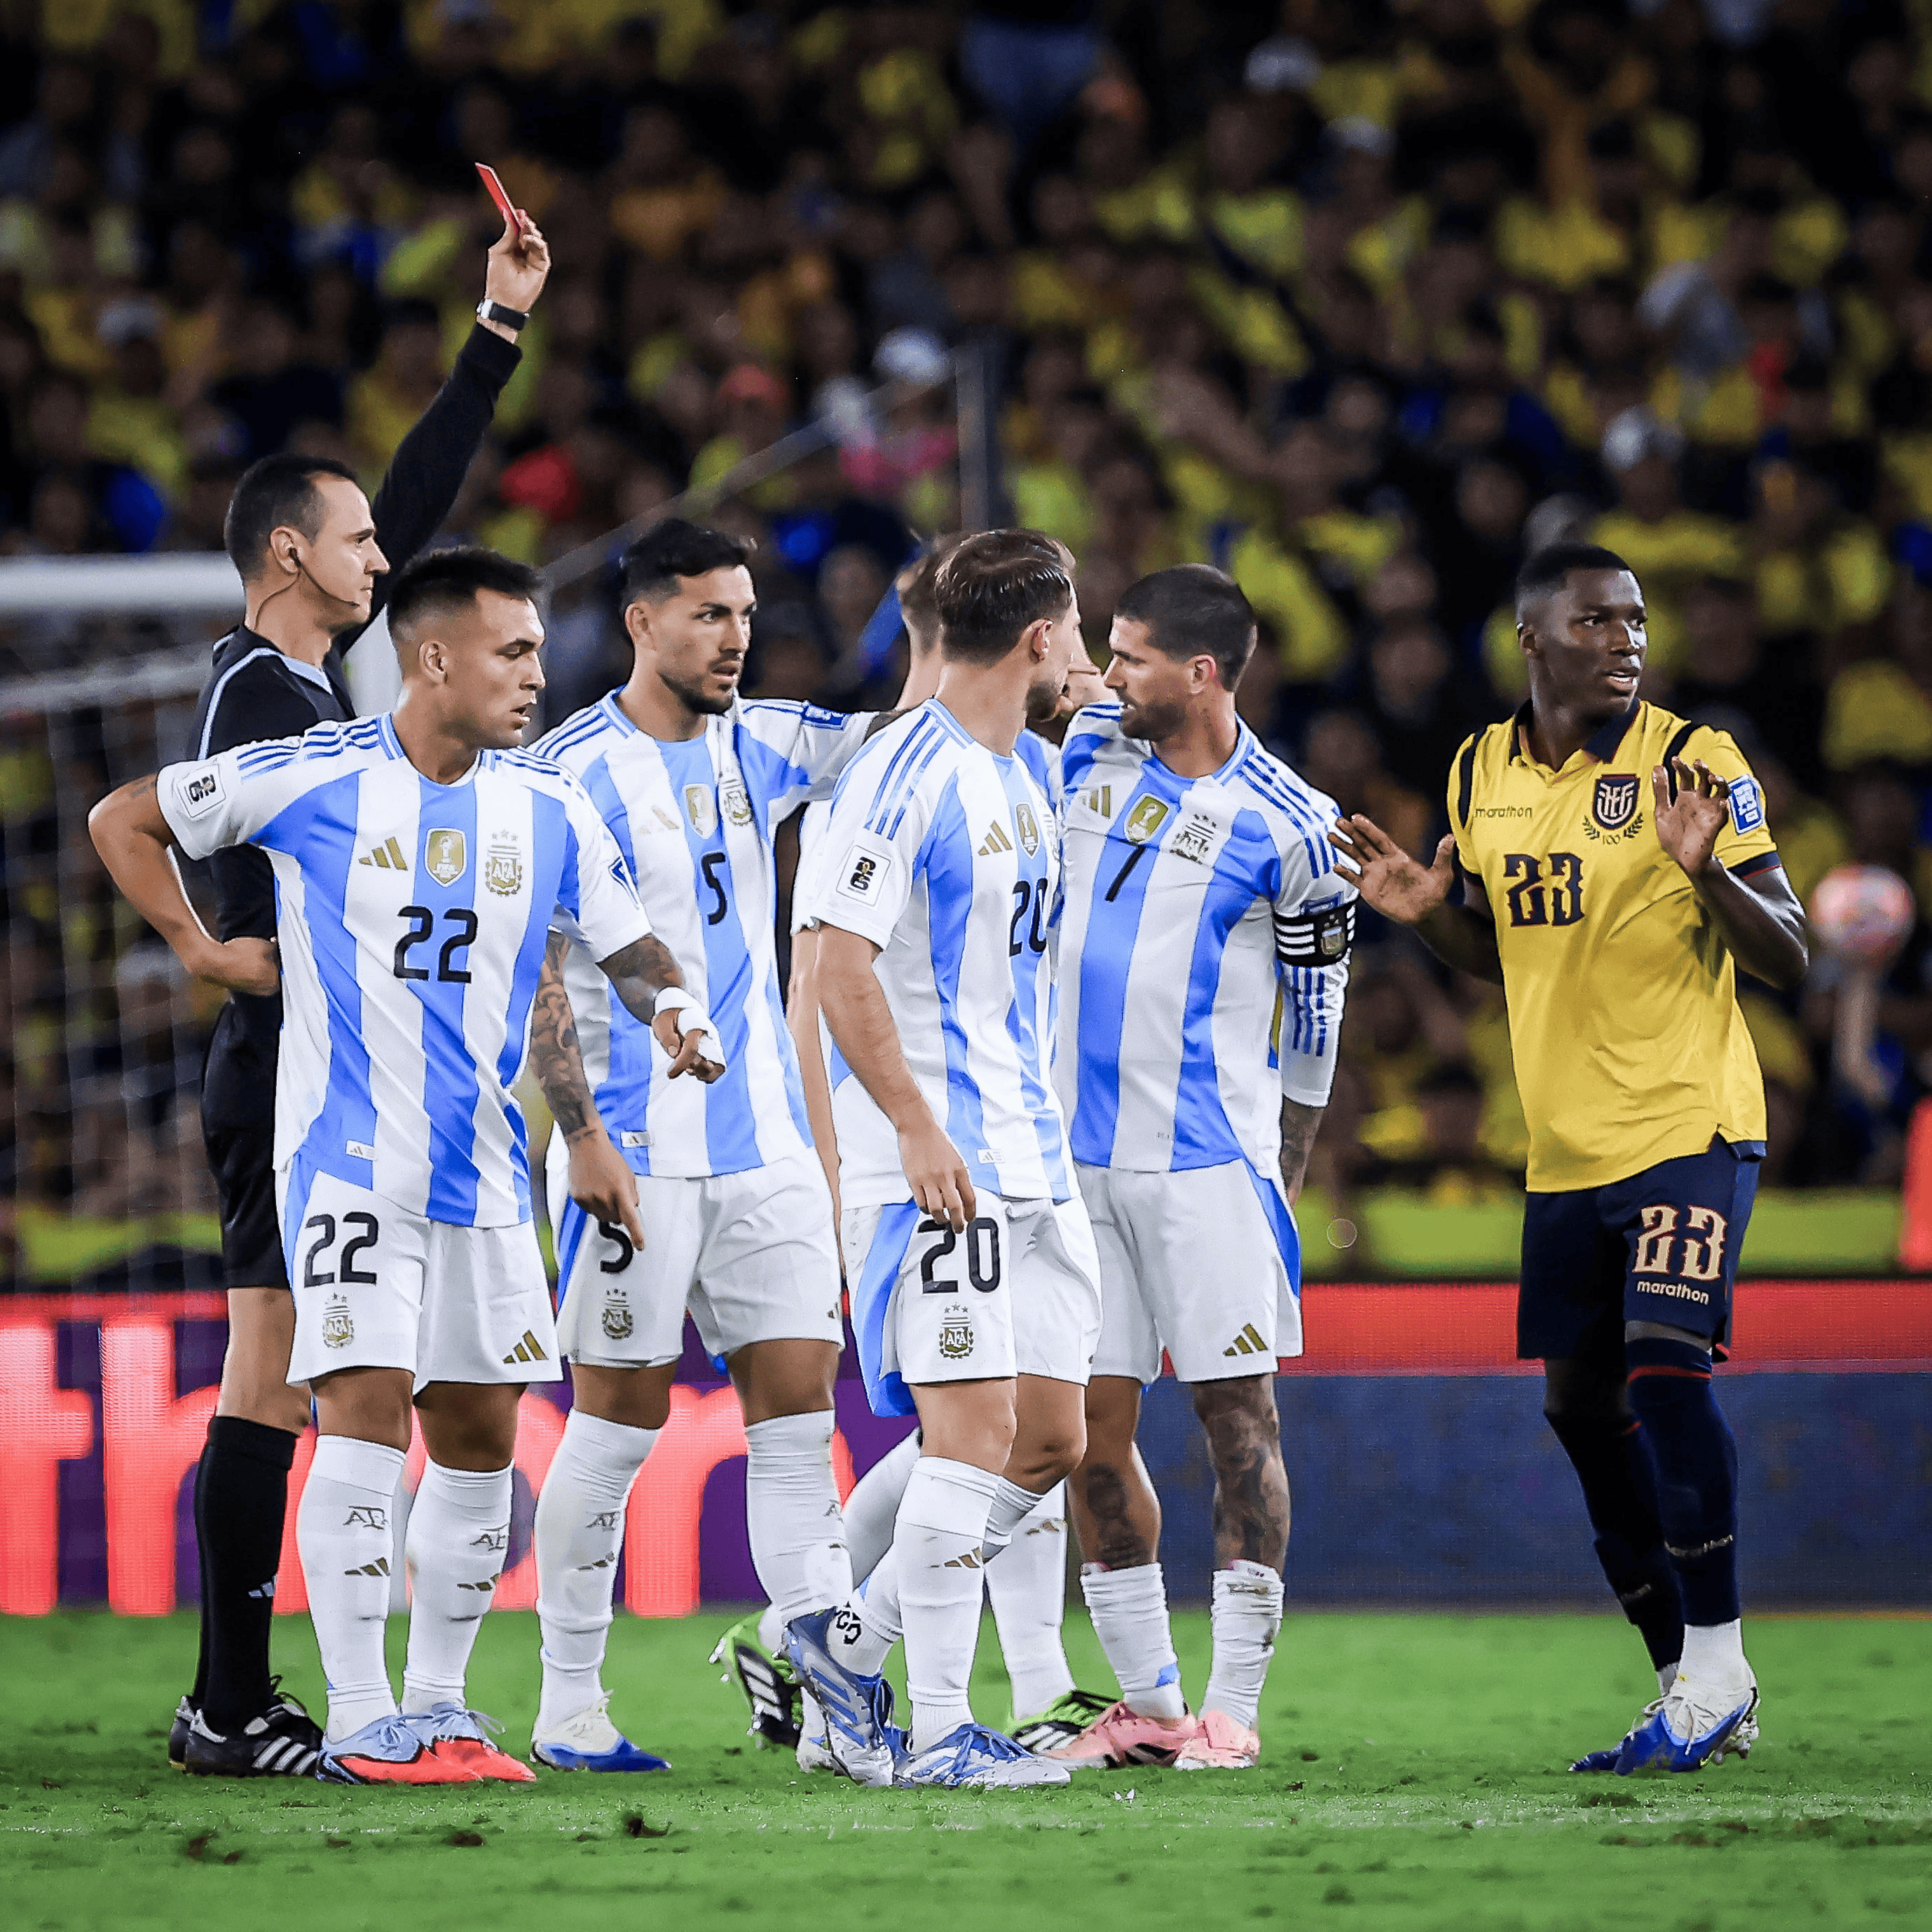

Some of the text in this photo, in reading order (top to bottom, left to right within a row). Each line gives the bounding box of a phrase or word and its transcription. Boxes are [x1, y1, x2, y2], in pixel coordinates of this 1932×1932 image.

[1474, 806, 1533, 819] marathon
[701, 851, 726, 926] 5
[1008, 877, 1048, 957] 20
[1503, 853, 1585, 927] 23
[393, 905, 478, 984] 22
[303, 1212, 379, 1288] 22
[599, 1221, 633, 1273] 5
[917, 1217, 1001, 1294] 20
[1632, 1205, 1729, 1281] 23
[1636, 1280, 1709, 1306] marathon
